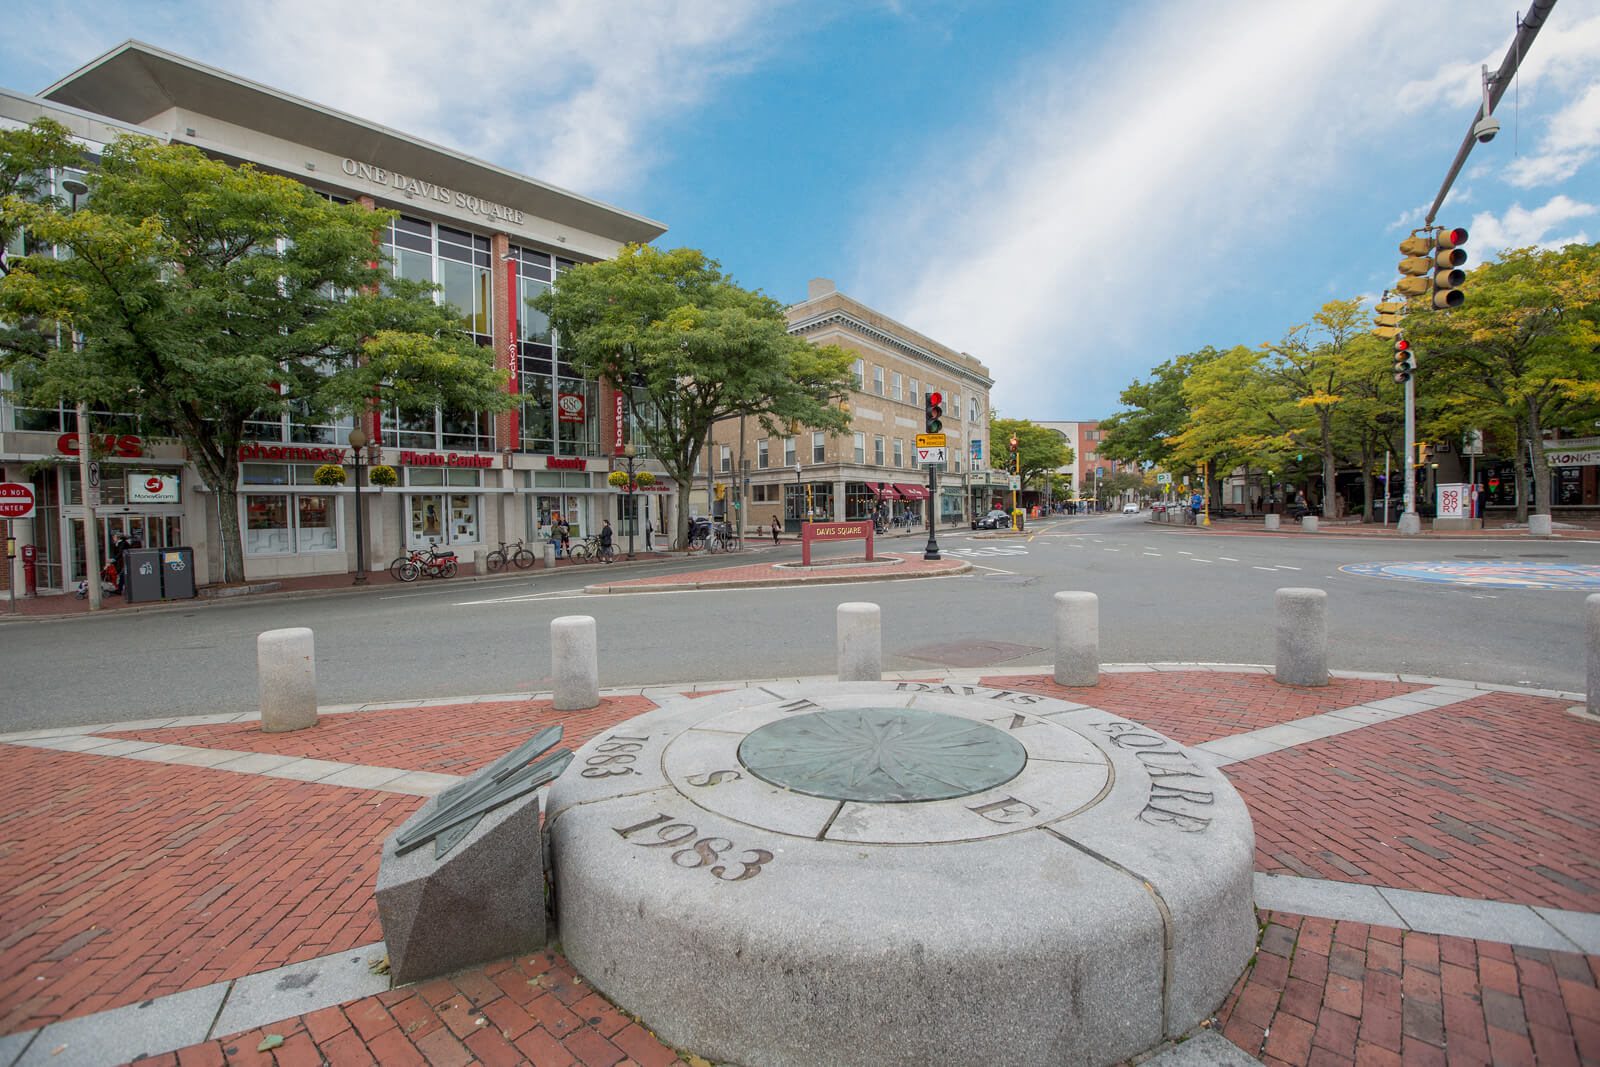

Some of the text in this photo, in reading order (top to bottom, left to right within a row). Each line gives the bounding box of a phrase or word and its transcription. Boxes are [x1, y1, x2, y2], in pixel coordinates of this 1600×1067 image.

[342, 158, 524, 225] ONE DAVIS SQUARE
[563, 398, 580, 411] BSC
[239, 442, 346, 464] pharmacy
[400, 451, 494, 467] Photo Center
[547, 456, 587, 471] Beauty
[816, 526, 862, 536] DAVIS SQUARE
[580, 734, 650, 779] 1883
[895, 683, 1214, 834] DAVIS SQUARE
[683, 769, 744, 788] S
[964, 795, 1040, 825] E
[611, 812, 775, 882] 1983
